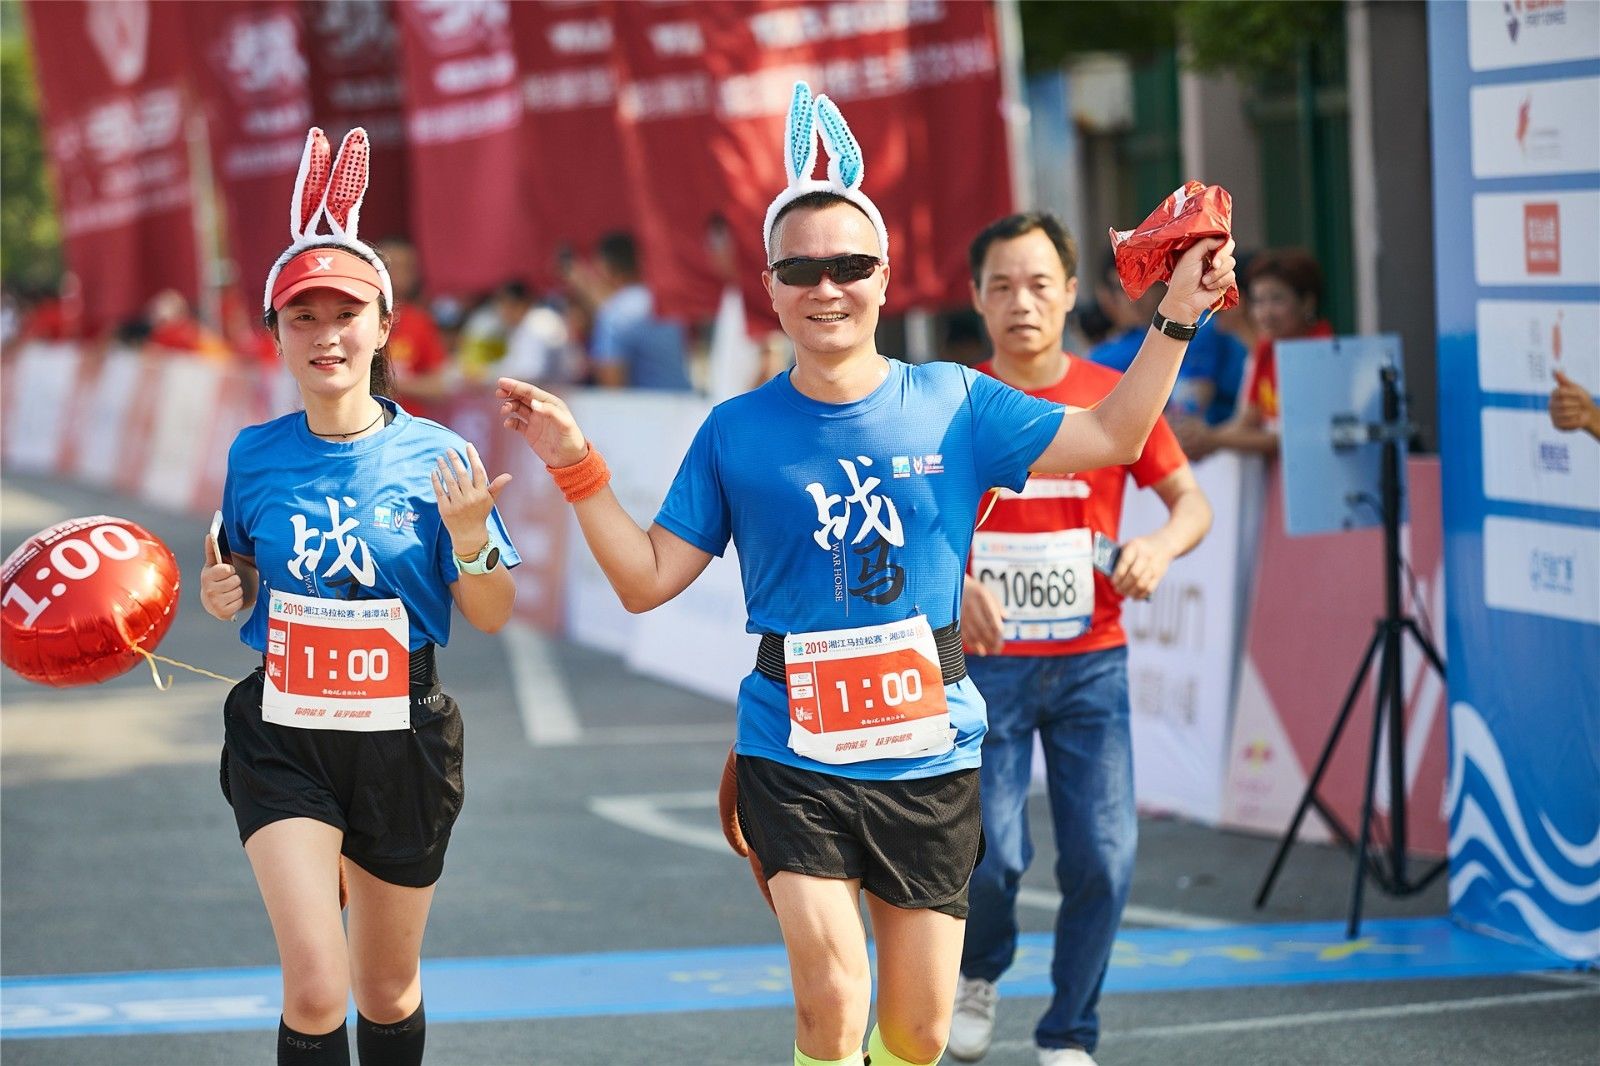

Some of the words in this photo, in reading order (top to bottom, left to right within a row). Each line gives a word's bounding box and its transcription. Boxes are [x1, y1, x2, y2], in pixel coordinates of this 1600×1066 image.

[831, 542, 841, 567] WAR
[1, 525, 140, 629] 1:00
[833, 569, 843, 602] HORSE
[303, 646, 389, 682] 1:00
[835, 668, 923, 713] 1:00
